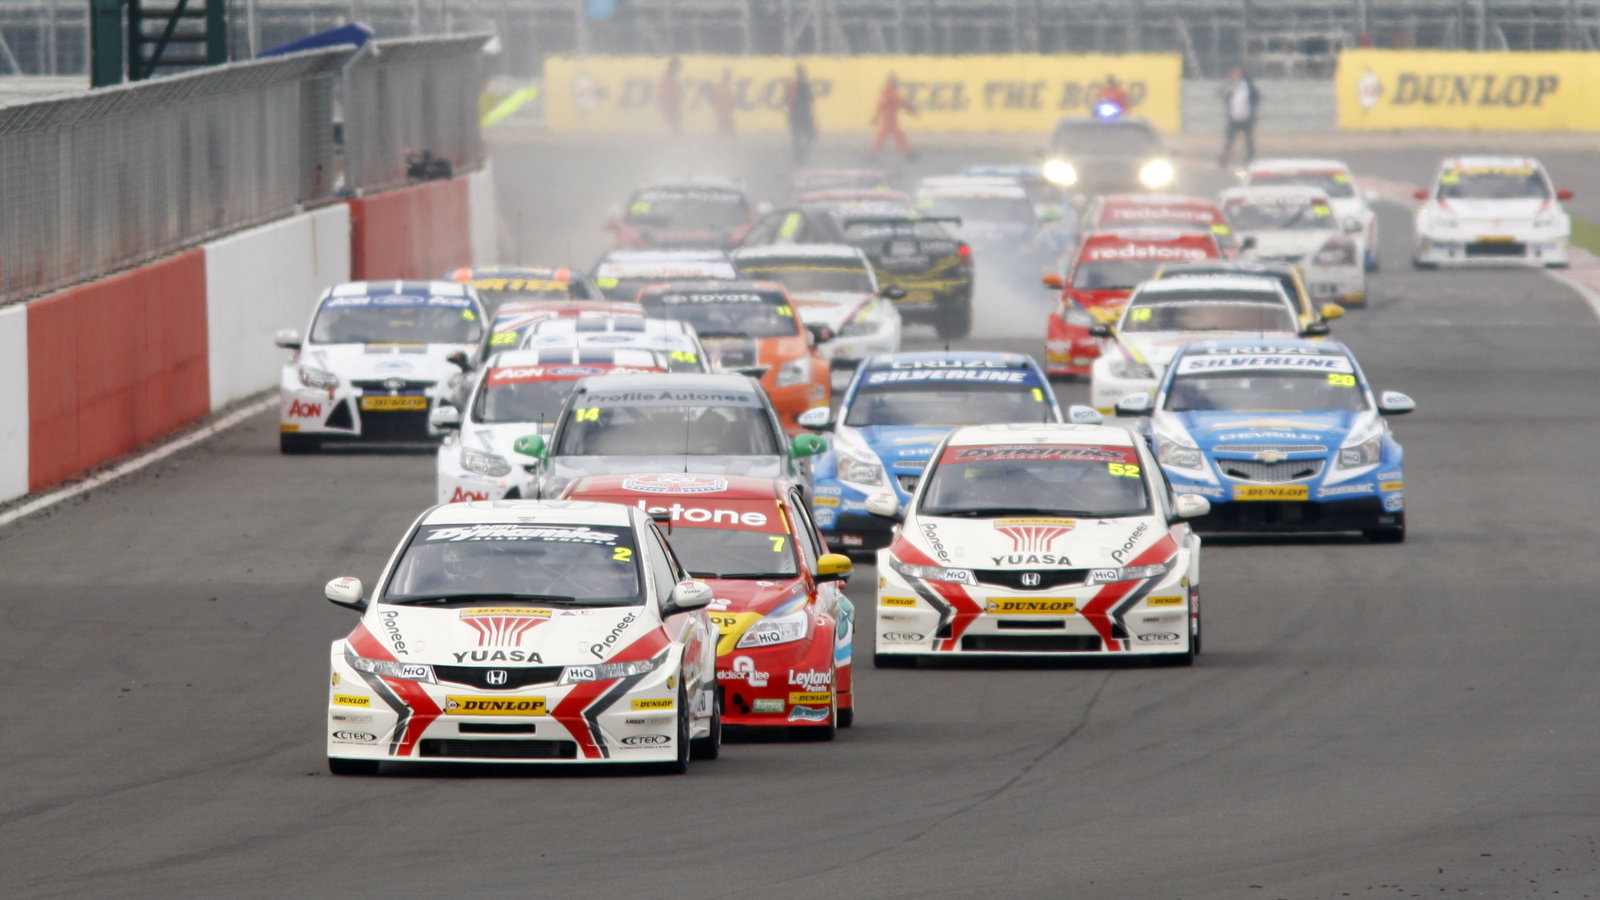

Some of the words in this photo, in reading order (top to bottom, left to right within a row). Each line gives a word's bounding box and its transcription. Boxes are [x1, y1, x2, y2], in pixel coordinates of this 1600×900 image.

[1391, 73, 1559, 107] DUNLOP
[1090, 243, 1207, 260] redstone
[689, 294, 762, 302] TOYOTA
[1188, 356, 1340, 369] SILVERLINE
[493, 367, 544, 380] AON
[868, 369, 1028, 384] SILVERLINE
[1327, 373, 1356, 387] 20
[587, 392, 656, 403] Profile
[289, 399, 321, 417] AON
[576, 407, 600, 422] 14
[1108, 462, 1141, 478] 52
[1247, 488, 1308, 496] DUNLOP
[767, 536, 785, 552] 7
[921, 523, 952, 563] Pioneer
[1111, 521, 1149, 564] Pioneer
[612, 547, 633, 562] 2
[991, 554, 1073, 567] YUASA
[945, 570, 968, 580] HiQ
[1094, 570, 1117, 580] HiQ
[1002, 602, 1074, 610] DUNLOP
[380, 610, 409, 656] Pioneer
[590, 611, 637, 660] Pioneer
[759, 631, 781, 644] HiQ
[452, 650, 545, 665] YUASA
[402, 666, 427, 678] HiQ
[570, 668, 595, 679] HiQ
[788, 667, 832, 688] Leyland
[806, 684, 828, 692] Paints
[338, 697, 370, 705] DUNLOP
[639, 699, 674, 708] DUNLOP
[798, 694, 830, 702] DUNLOP
[463, 700, 545, 711] DUNLOP
[341, 731, 367, 741] CTEK
[631, 736, 660, 745] CTEK
